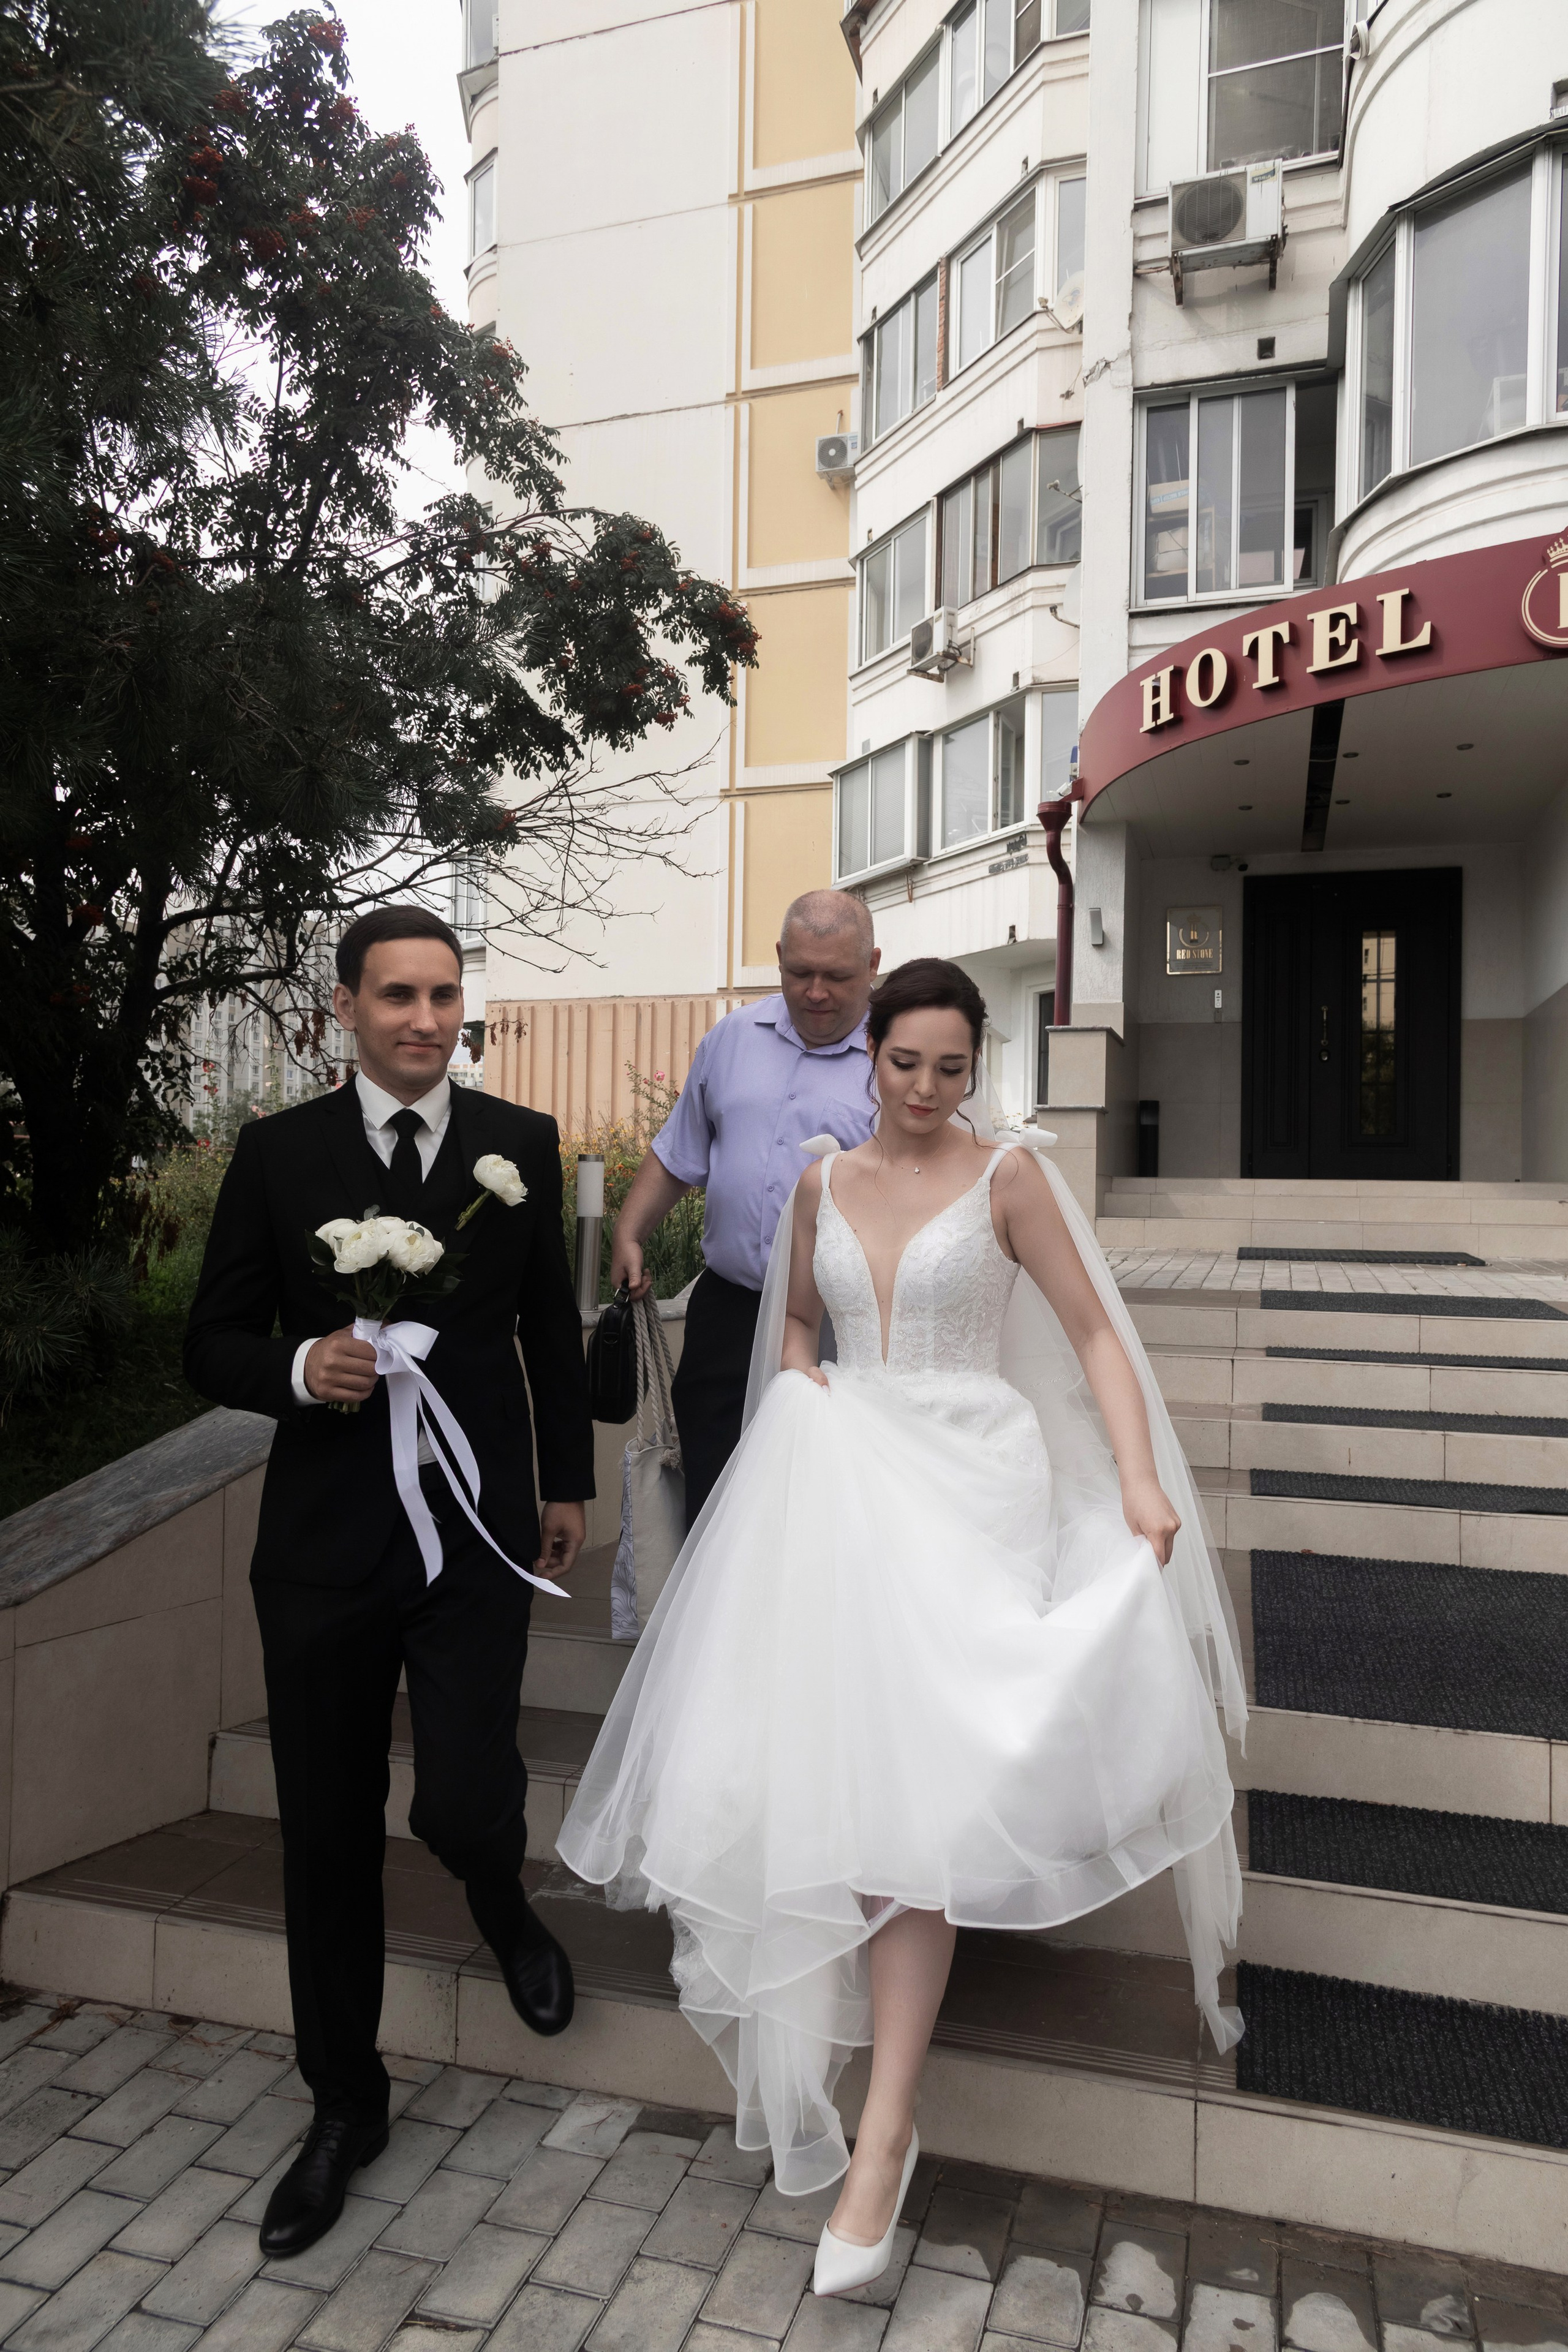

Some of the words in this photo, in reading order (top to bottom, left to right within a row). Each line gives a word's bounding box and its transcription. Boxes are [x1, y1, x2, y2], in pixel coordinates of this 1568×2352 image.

[1139, 587, 1432, 734] HOTEL
[1176, 949, 1191, 960] RED
[1192, 948, 1213, 959] STONE
